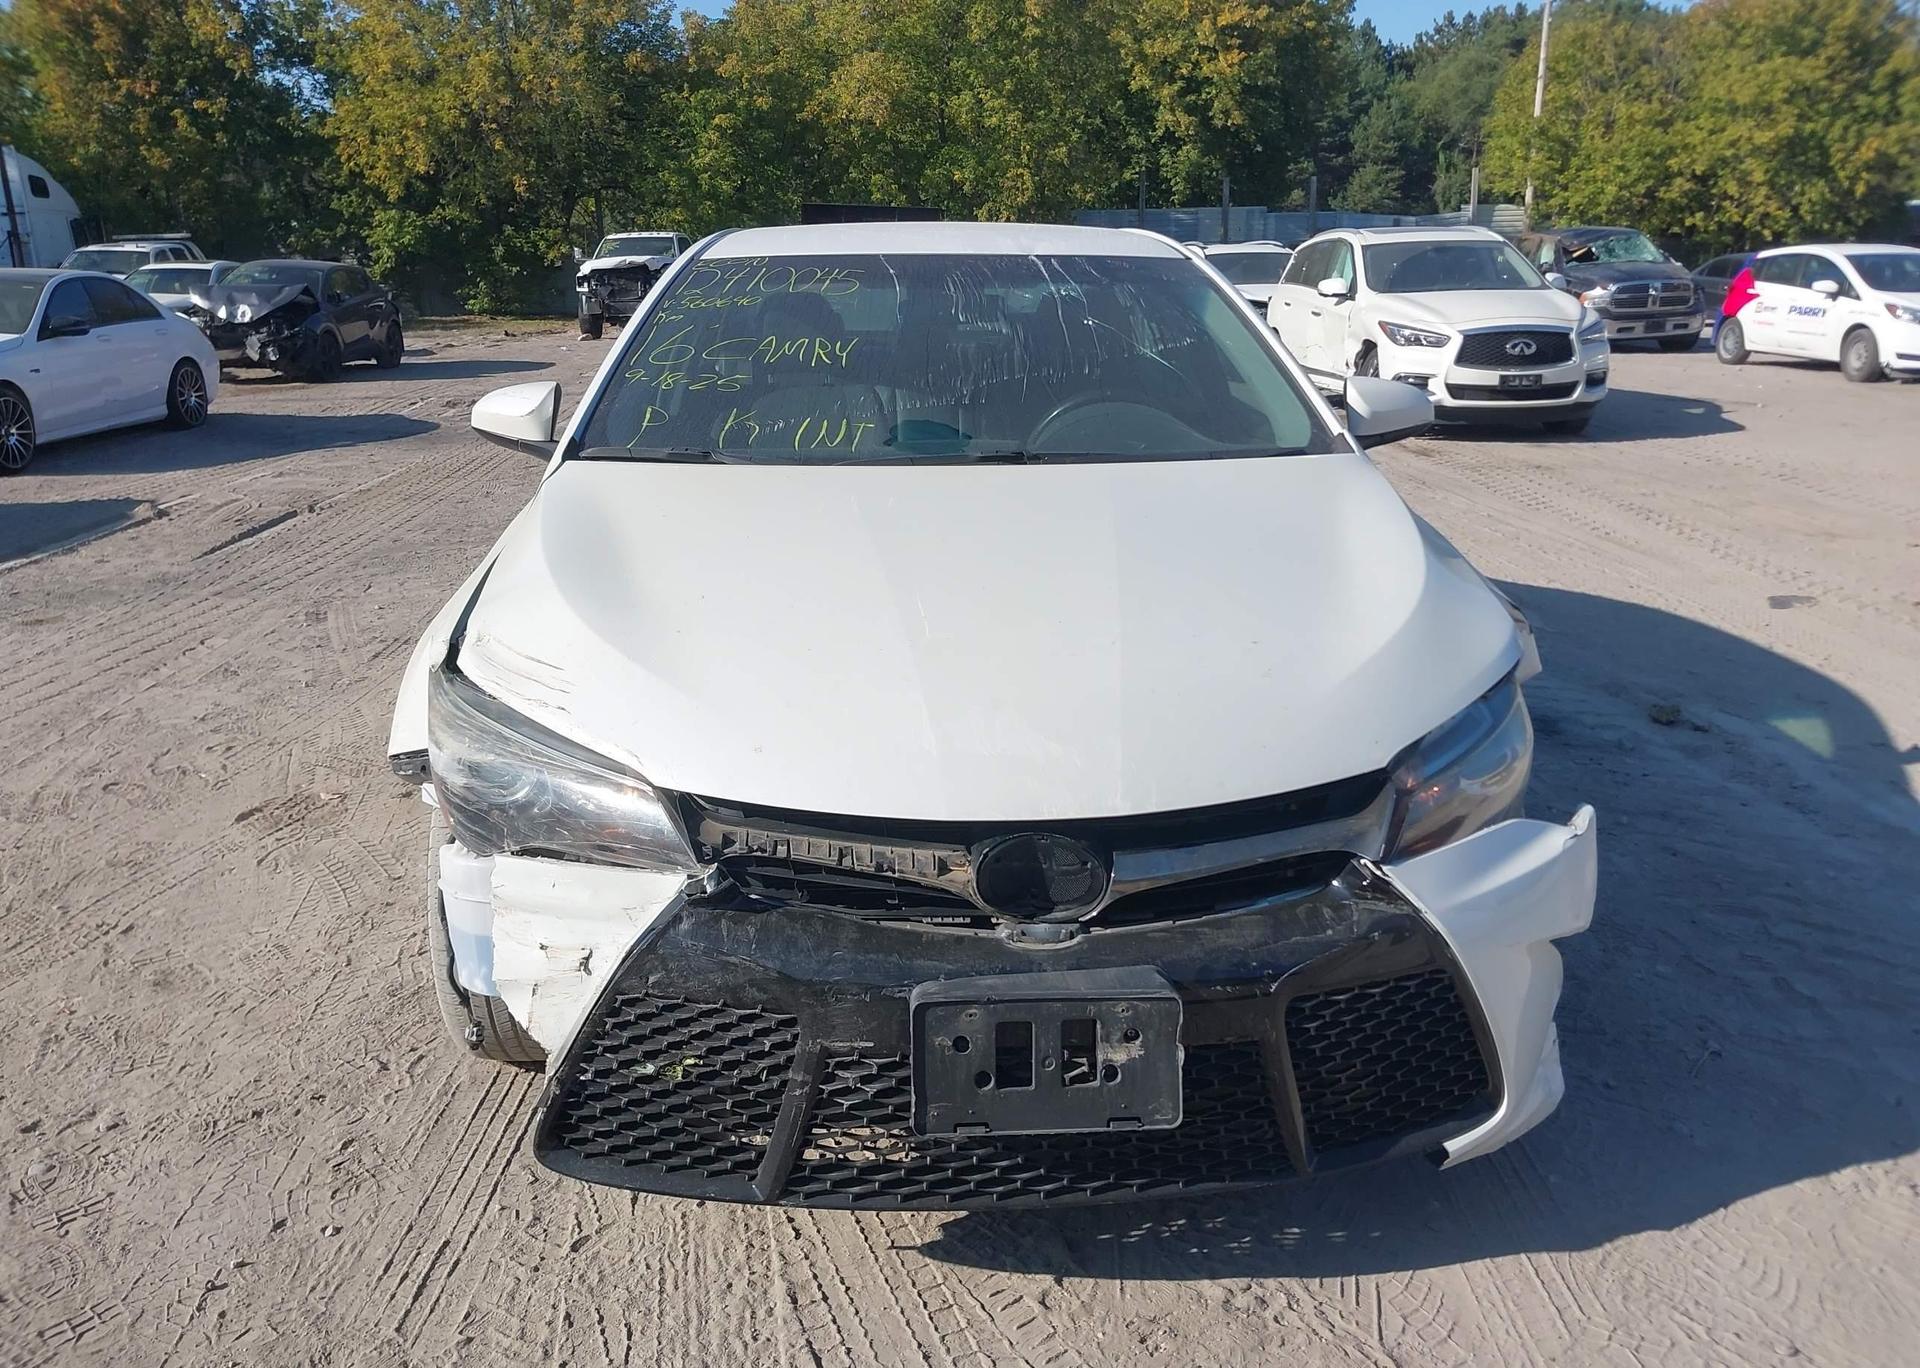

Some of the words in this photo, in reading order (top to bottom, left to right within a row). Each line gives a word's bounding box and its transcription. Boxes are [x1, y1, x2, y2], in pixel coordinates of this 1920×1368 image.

[1787, 305, 1827, 318] PARRY
[630, 325, 695, 366] 16
[702, 335, 859, 368] CAMRY
[625, 368, 752, 392] 9-18-25
[794, 417, 875, 452] INT
